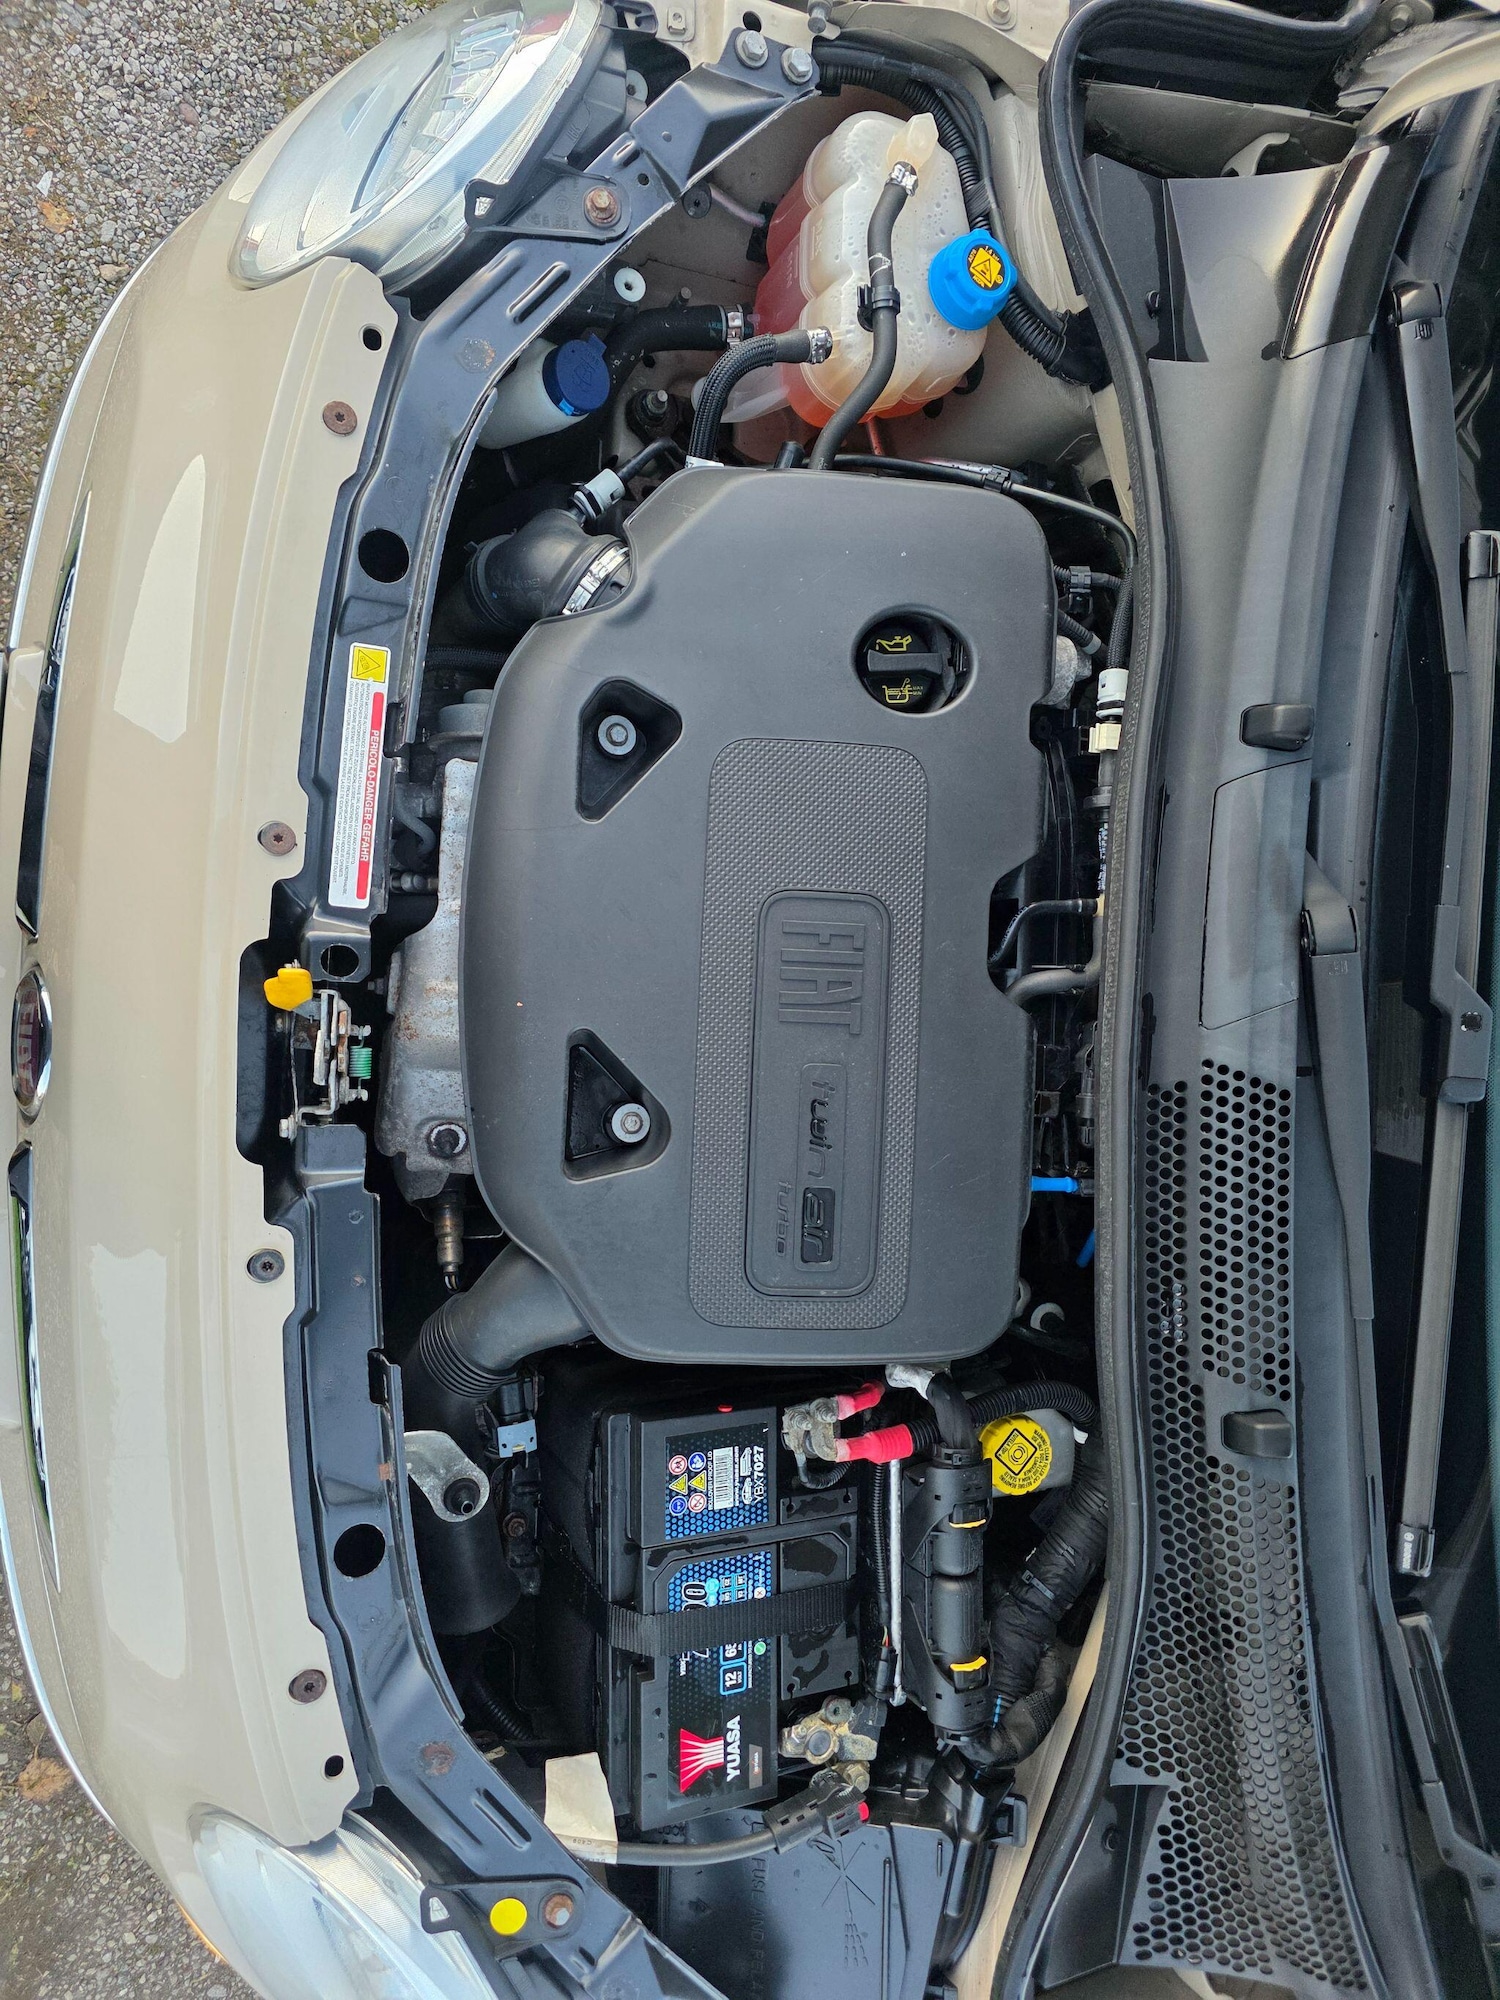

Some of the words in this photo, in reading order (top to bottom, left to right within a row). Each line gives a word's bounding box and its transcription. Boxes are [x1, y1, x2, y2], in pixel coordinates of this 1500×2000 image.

[360, 730, 379, 862] PERICOLO-DANGER-GEFAHR
[778, 919, 866, 1035] FIAT
[17, 1003, 35, 1088] FIAT
[775, 1181, 793, 1258] turbo
[753, 1445, 764, 1504] YBX7027
[1017, 1481, 1033, 1490] BEFORE
[1033, 1476, 1041, 1484] CAP
[1039, 1462, 1049, 1476] FILLER
[725, 1671, 737, 1687] 12
[726, 1714, 741, 1782] YUASA
[751, 1857, 767, 1900] FUSE
[750, 1905, 765, 1942] AND
